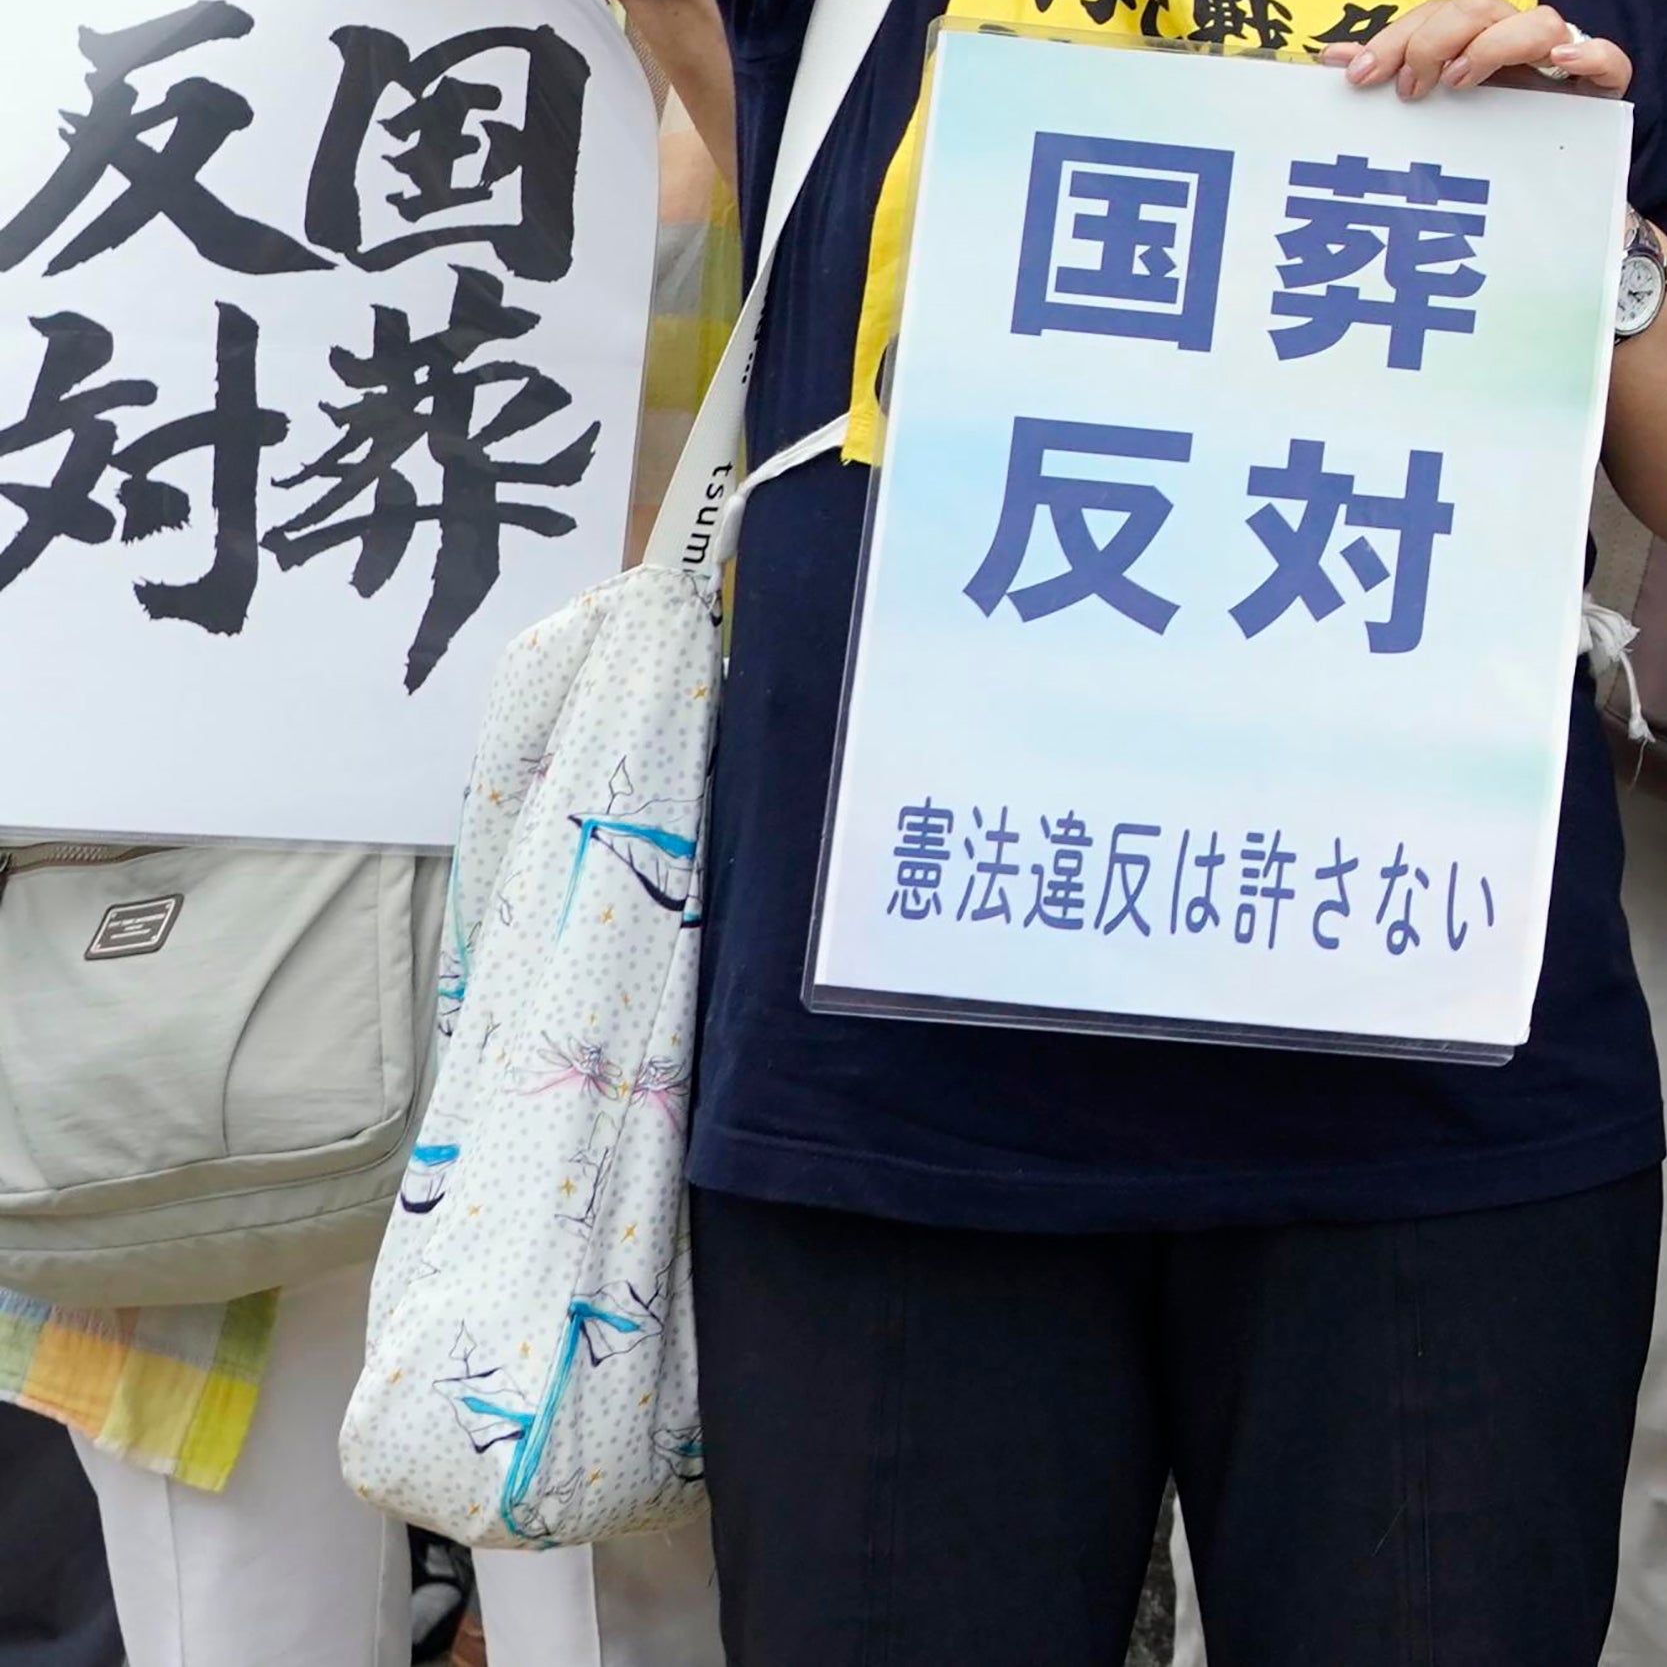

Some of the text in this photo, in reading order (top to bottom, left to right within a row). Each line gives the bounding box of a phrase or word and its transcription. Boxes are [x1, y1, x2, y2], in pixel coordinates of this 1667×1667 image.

[260, 21, 601, 696] 国葬
[1009, 131, 1491, 371] 国葬
[682, 460, 734, 577] tsum
[961, 416, 1456, 654] 反対
[886, 795, 1499, 957] 憲法違反は許さない
